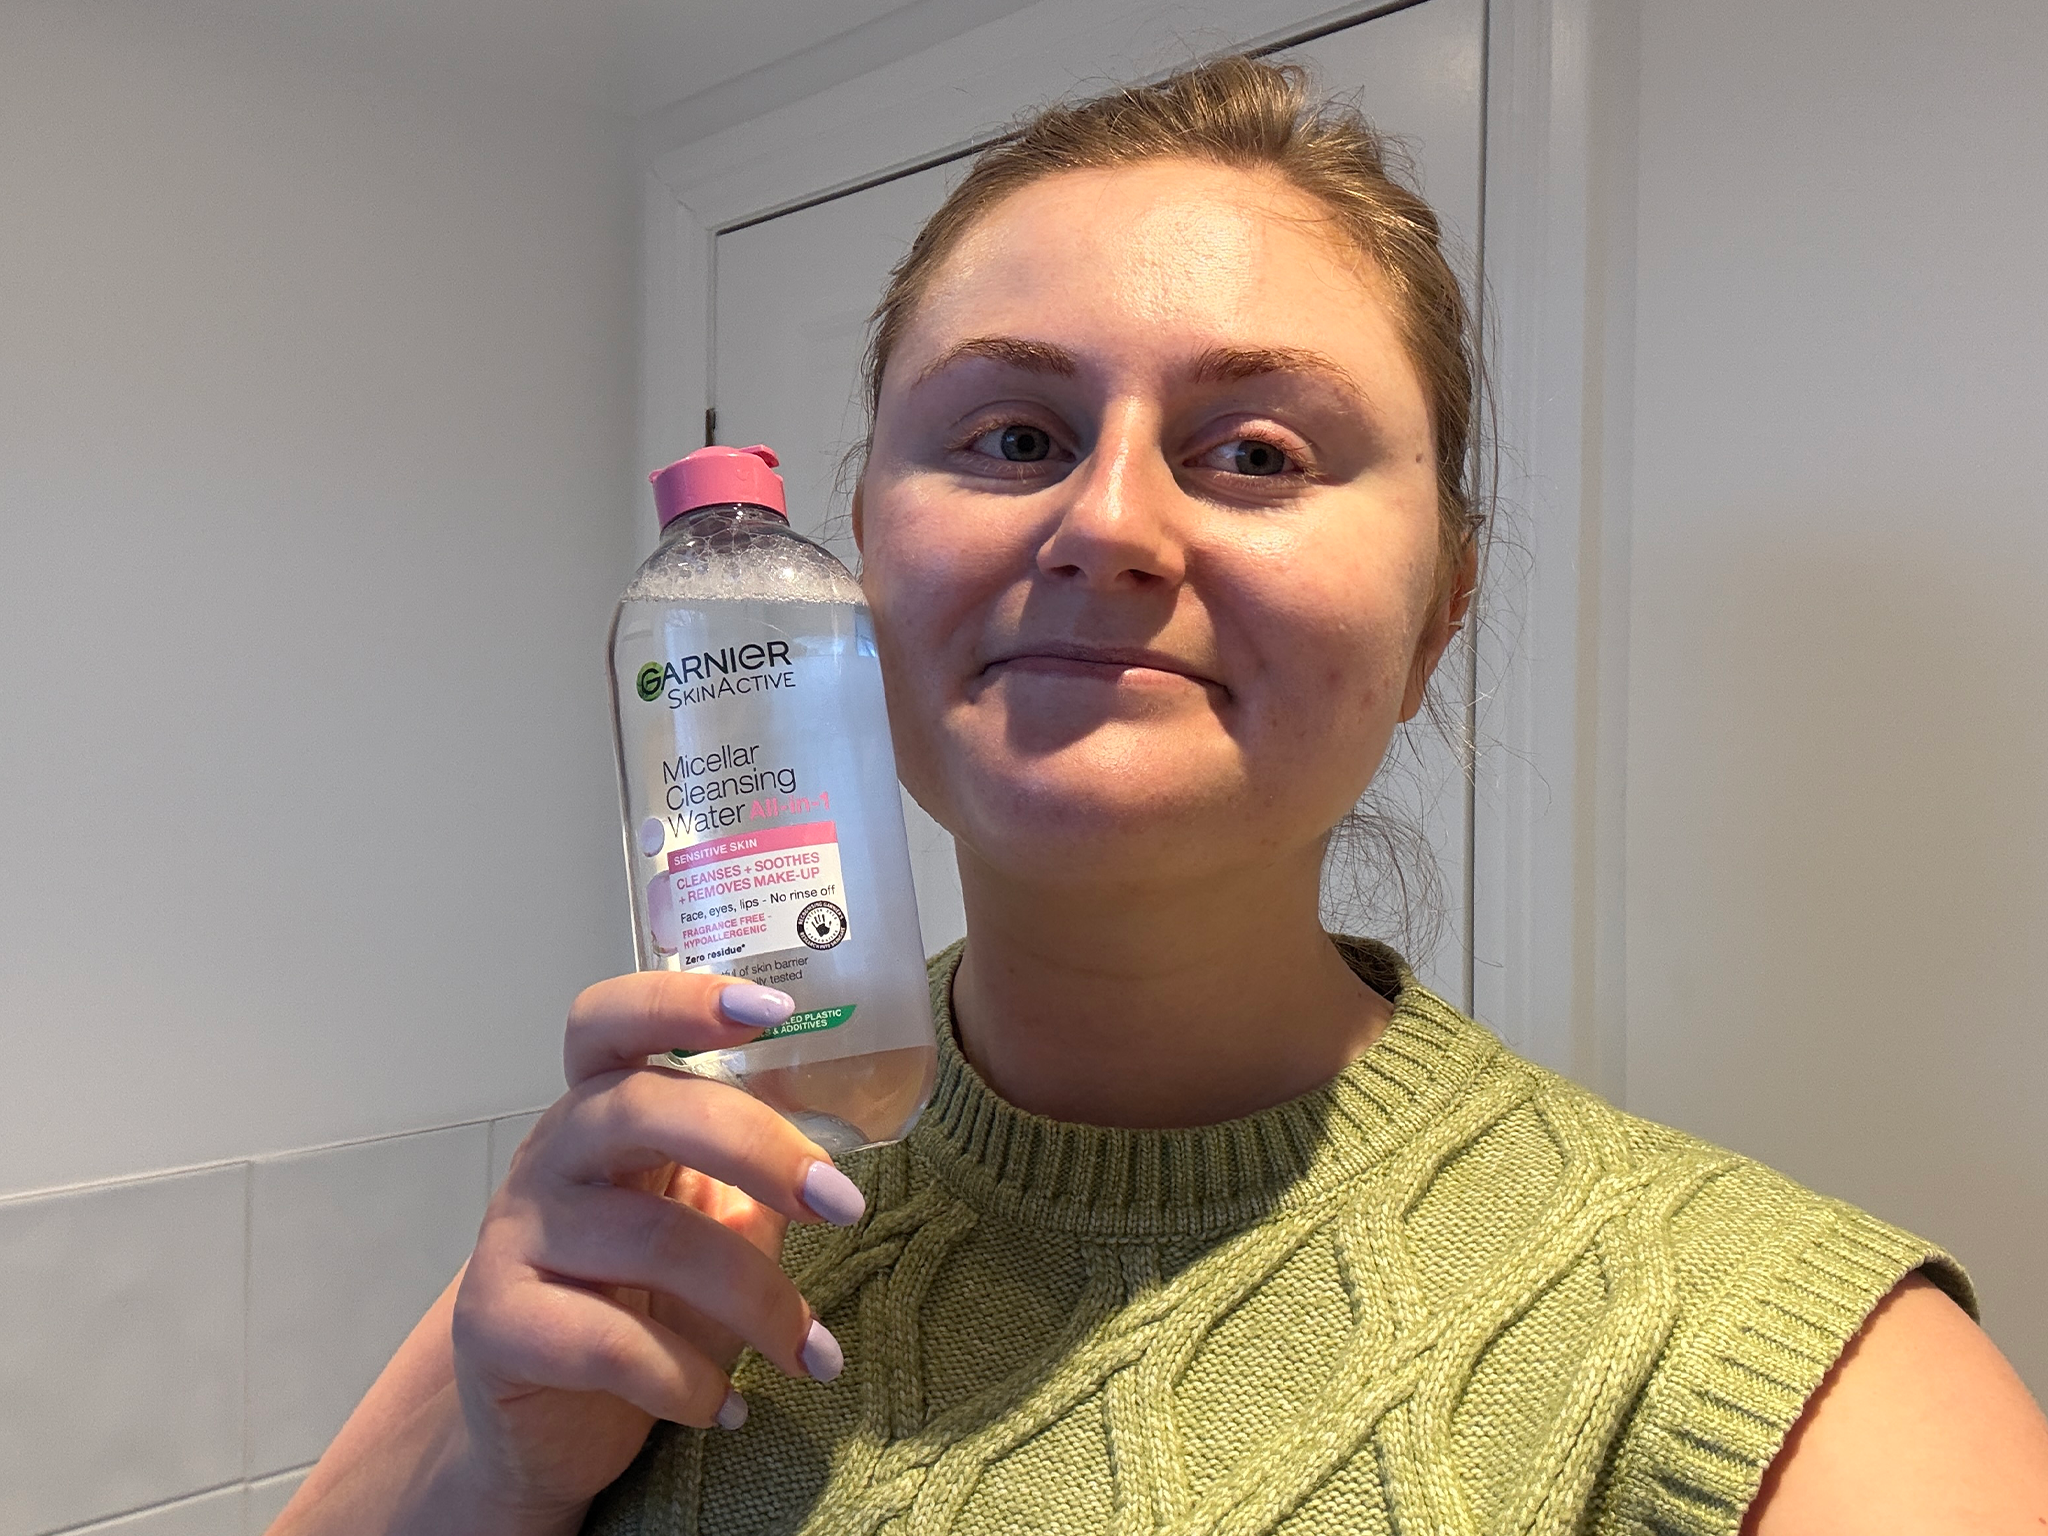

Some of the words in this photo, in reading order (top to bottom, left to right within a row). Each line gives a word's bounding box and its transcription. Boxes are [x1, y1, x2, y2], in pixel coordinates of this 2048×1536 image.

[639, 641, 792, 697] GARNIER
[663, 745, 759, 784] Micellar
[666, 767, 796, 810] Cleansing
[667, 803, 746, 838] Water
[750, 791, 830, 820] All-in-1
[674, 844, 727, 866] SENSITIVE
[729, 837, 758, 852] SKIN
[676, 864, 741, 890] CLEANSES
[744, 866, 751, 874] +
[754, 851, 820, 873] SOOTHES
[678, 896, 686, 905] +
[688, 877, 752, 903] REMOVES
[754, 866, 820, 888] MAKE-UP
[680, 909, 707, 924] Face,
[709, 903, 737, 917] eyes,
[739, 896, 759, 911] lips
[770, 891, 787, 904] No
[789, 887, 818, 902] rinse
[820, 884, 836, 896] off
[682, 918, 737, 939] FRAGRANCE
[740, 912, 766, 925] FREE
[684, 924, 767, 950] HYPOALLERGENIC
[685, 954, 705, 965] Zero
[739, 965, 749, 977] of
[751, 962, 773, 974] skin
[774, 956, 809, 970] barrier
[770, 969, 803, 984] tested
[772, 1027, 779, 1035] &
[781, 1019, 828, 1034] ADDITIVES
[805, 1009, 842, 1021] PLASTIC
